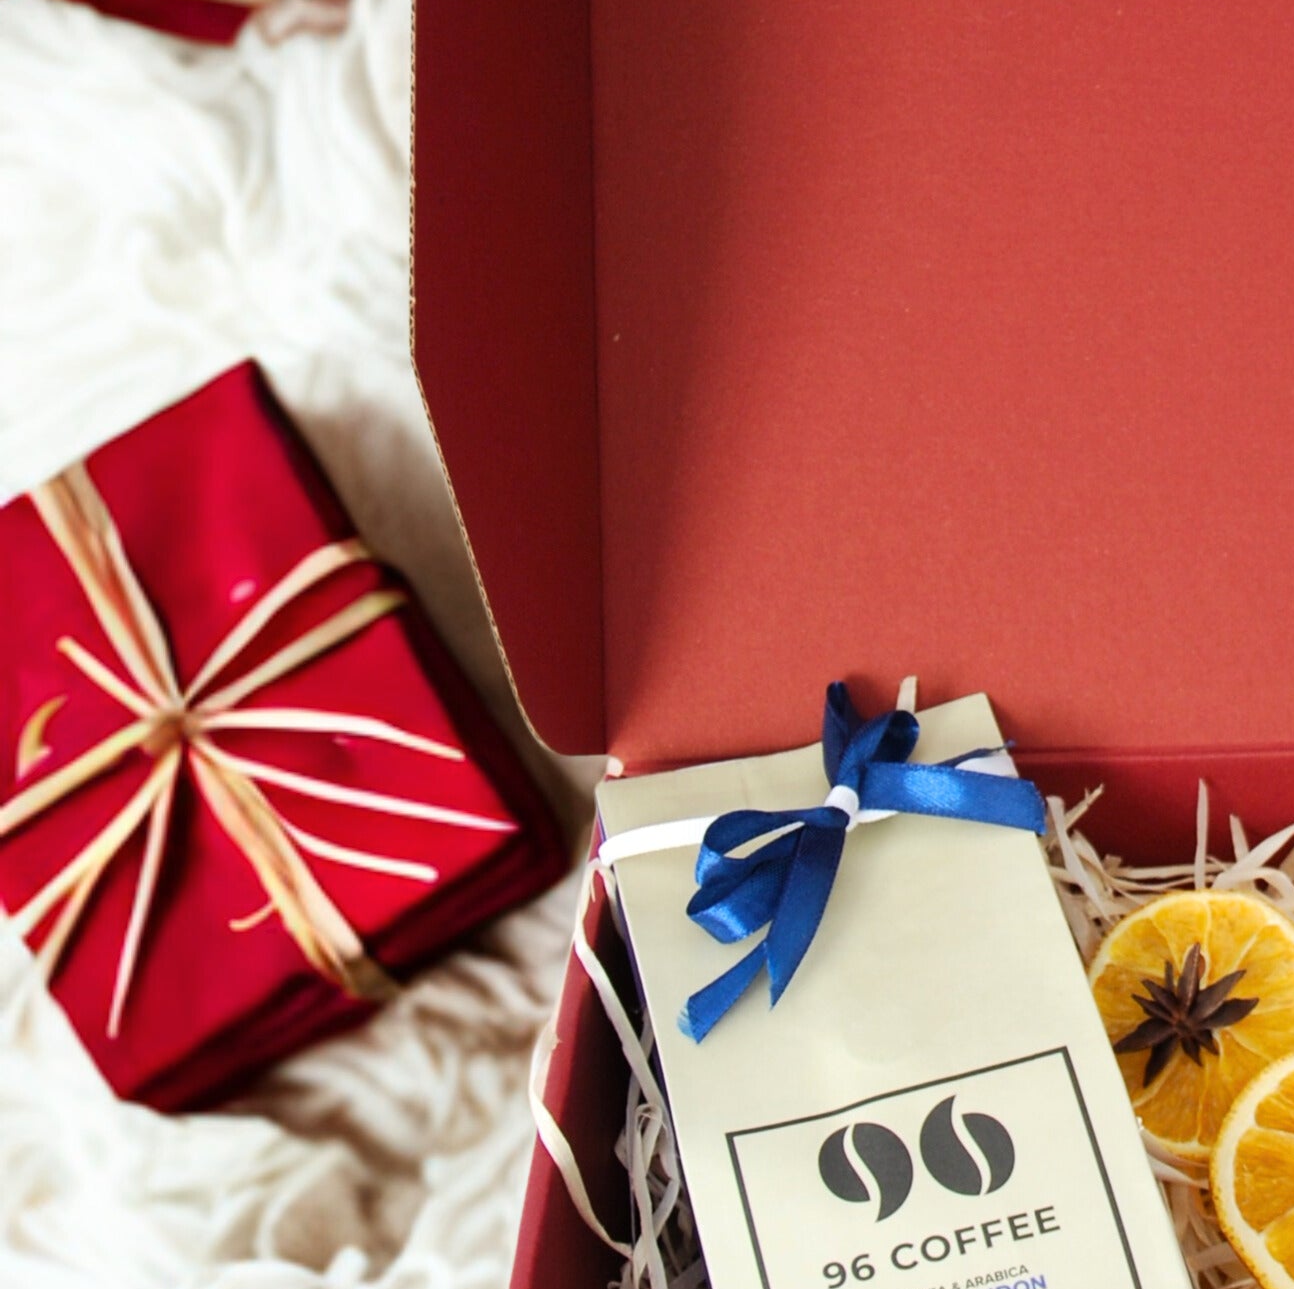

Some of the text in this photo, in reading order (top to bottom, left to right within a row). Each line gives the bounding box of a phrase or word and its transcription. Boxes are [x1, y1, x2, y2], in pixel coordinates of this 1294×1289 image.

[822, 1205, 1061, 1289] 96 COFFEE
[965, 1264, 1029, 1289] ARABICA
